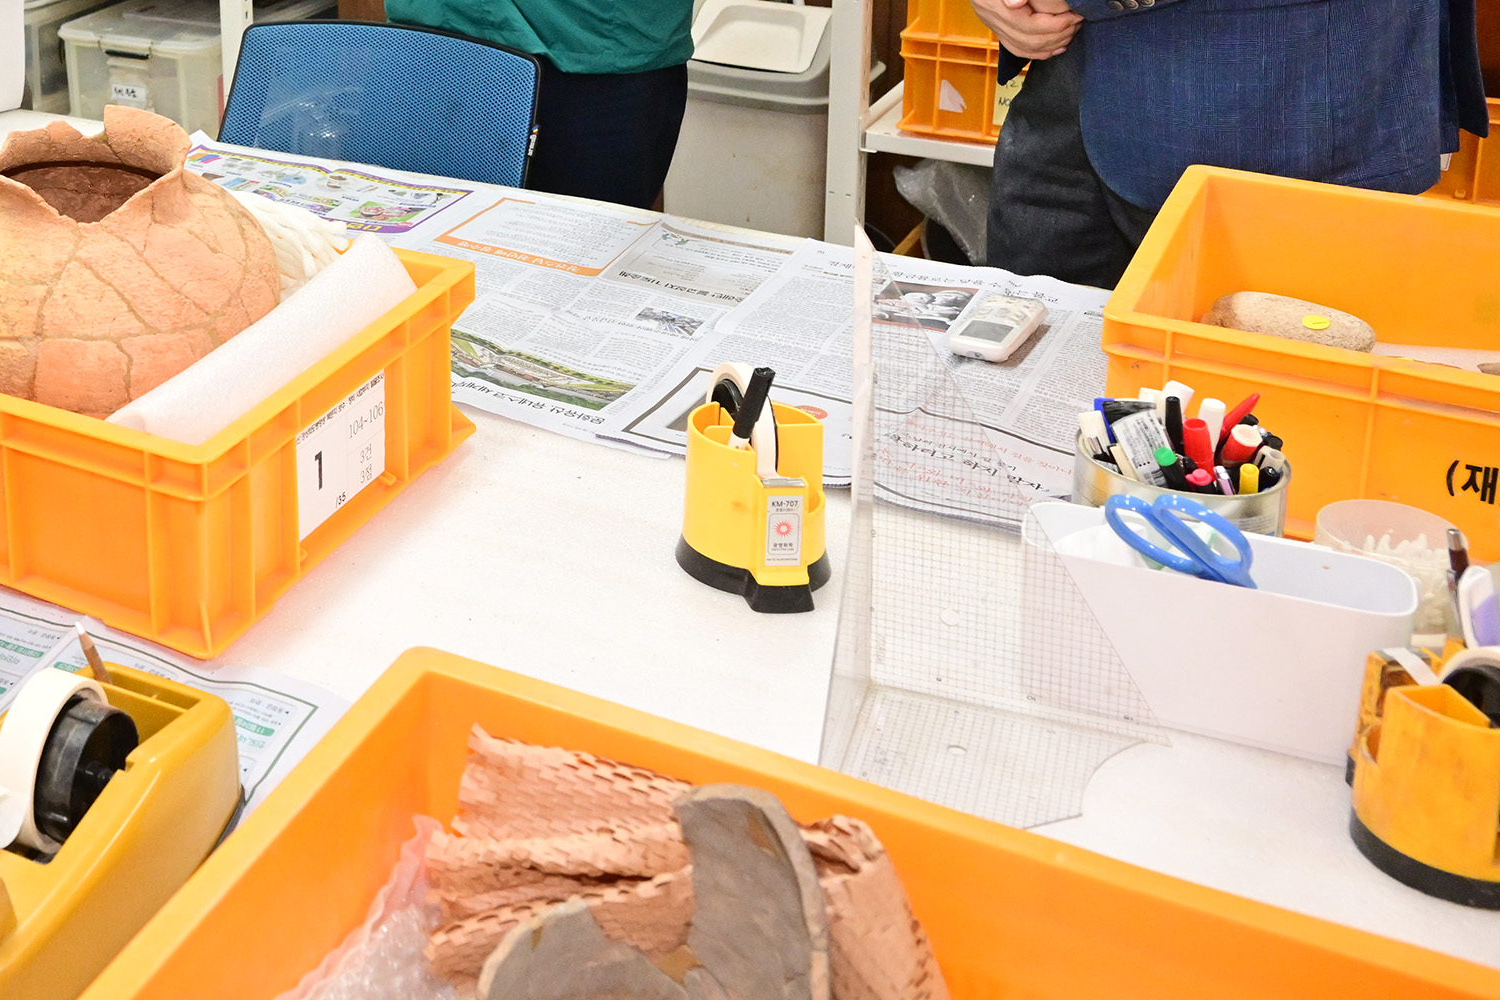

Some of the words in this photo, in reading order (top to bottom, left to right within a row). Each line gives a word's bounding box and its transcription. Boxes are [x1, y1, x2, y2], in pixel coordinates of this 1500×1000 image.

[349, 401, 384, 439] 104~106
[549, 405, 605, 424] 문화유산,
[314, 450, 322, 490] 1
[336, 492, 346, 508] /35
